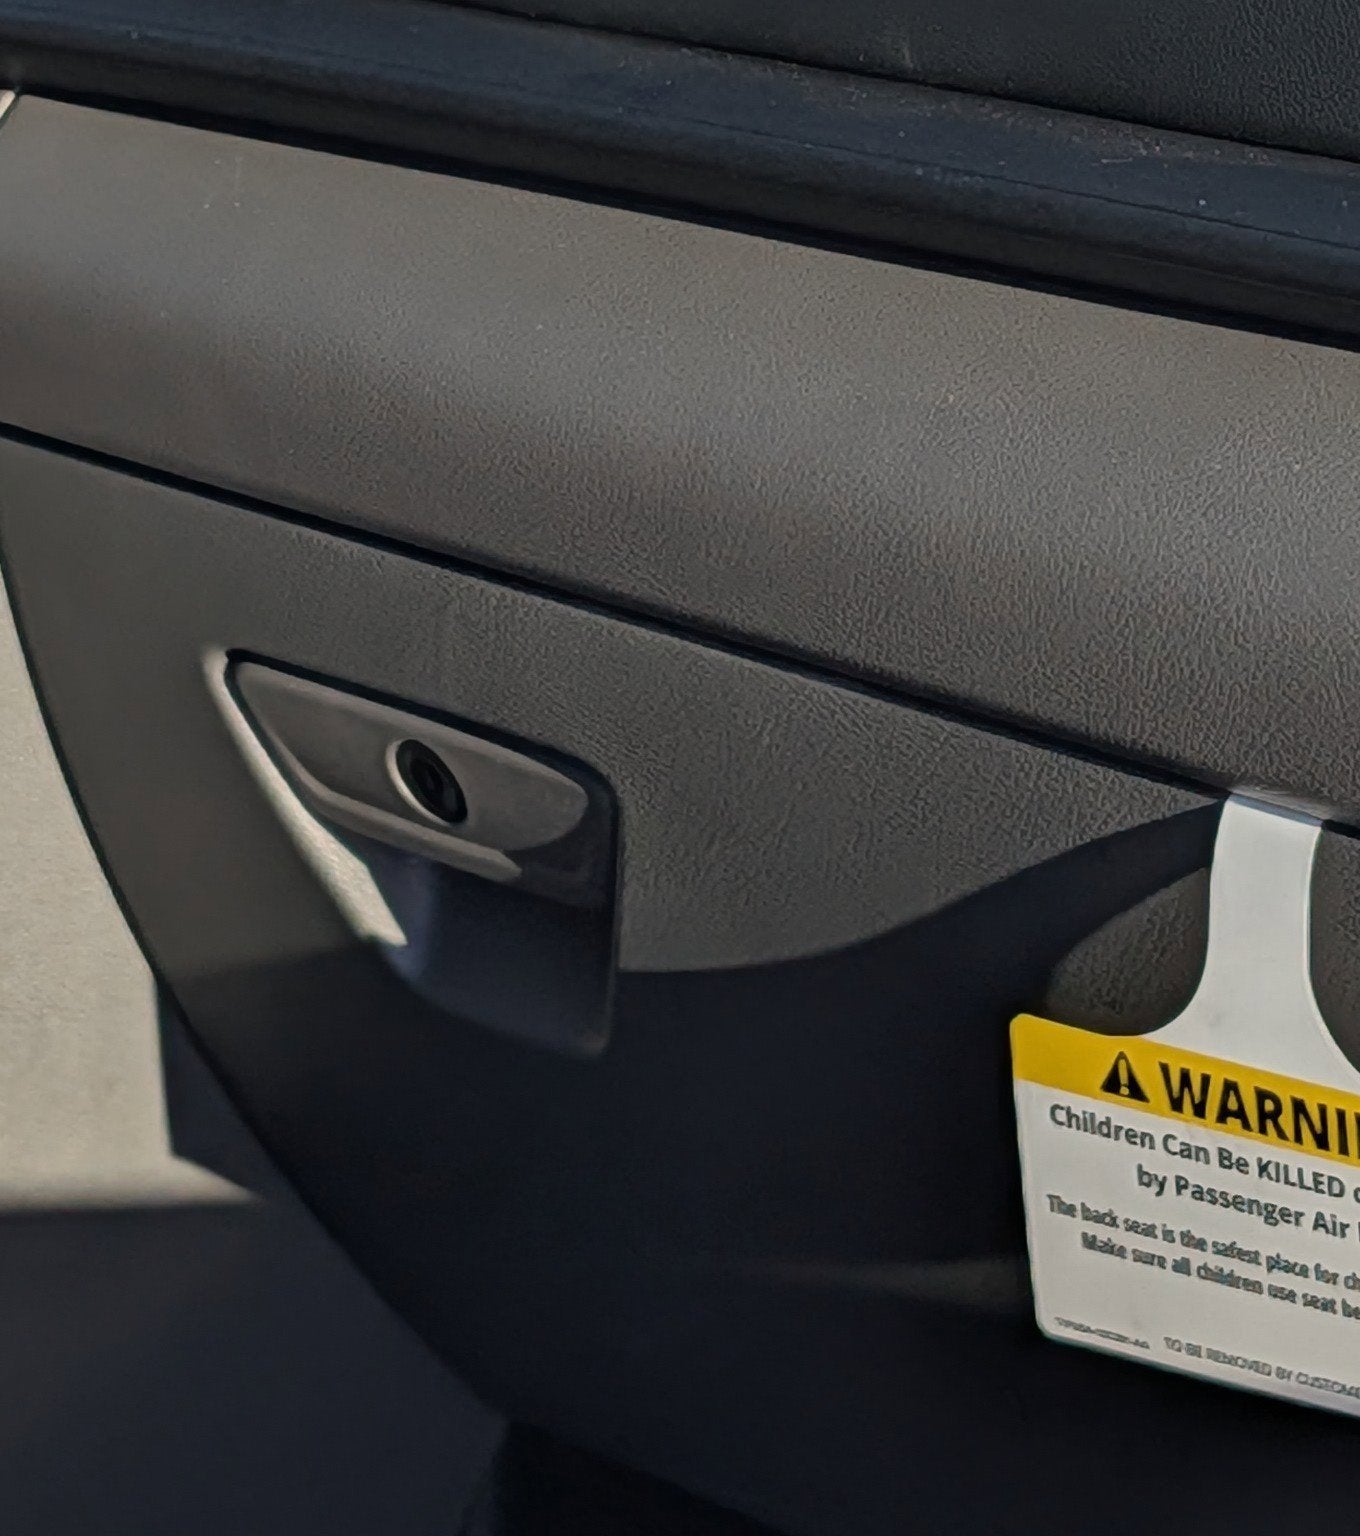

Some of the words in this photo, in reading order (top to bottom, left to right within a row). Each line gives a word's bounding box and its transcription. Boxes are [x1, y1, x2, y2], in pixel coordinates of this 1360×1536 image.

[1049, 1103, 1156, 1150] Children
[1162, 1134, 1210, 1165] Can
[1217, 1146, 1250, 1175] Be
[1256, 1157, 1346, 1200] KILLED
[1047, 1194, 1077, 1218] The
[1080, 1202, 1120, 1228] back
[1123, 1217, 1158, 1239] seat
[1179, 1230, 1208, 1252] the
[1211, 1241, 1262, 1266] safest
[1265, 1253, 1310, 1279] place
[1313, 1263, 1339, 1286] for
[1137, 1164, 1167, 1197] by
[1175, 1175, 1306, 1227] Passenger
[1312, 1211, 1350, 1239] Air
